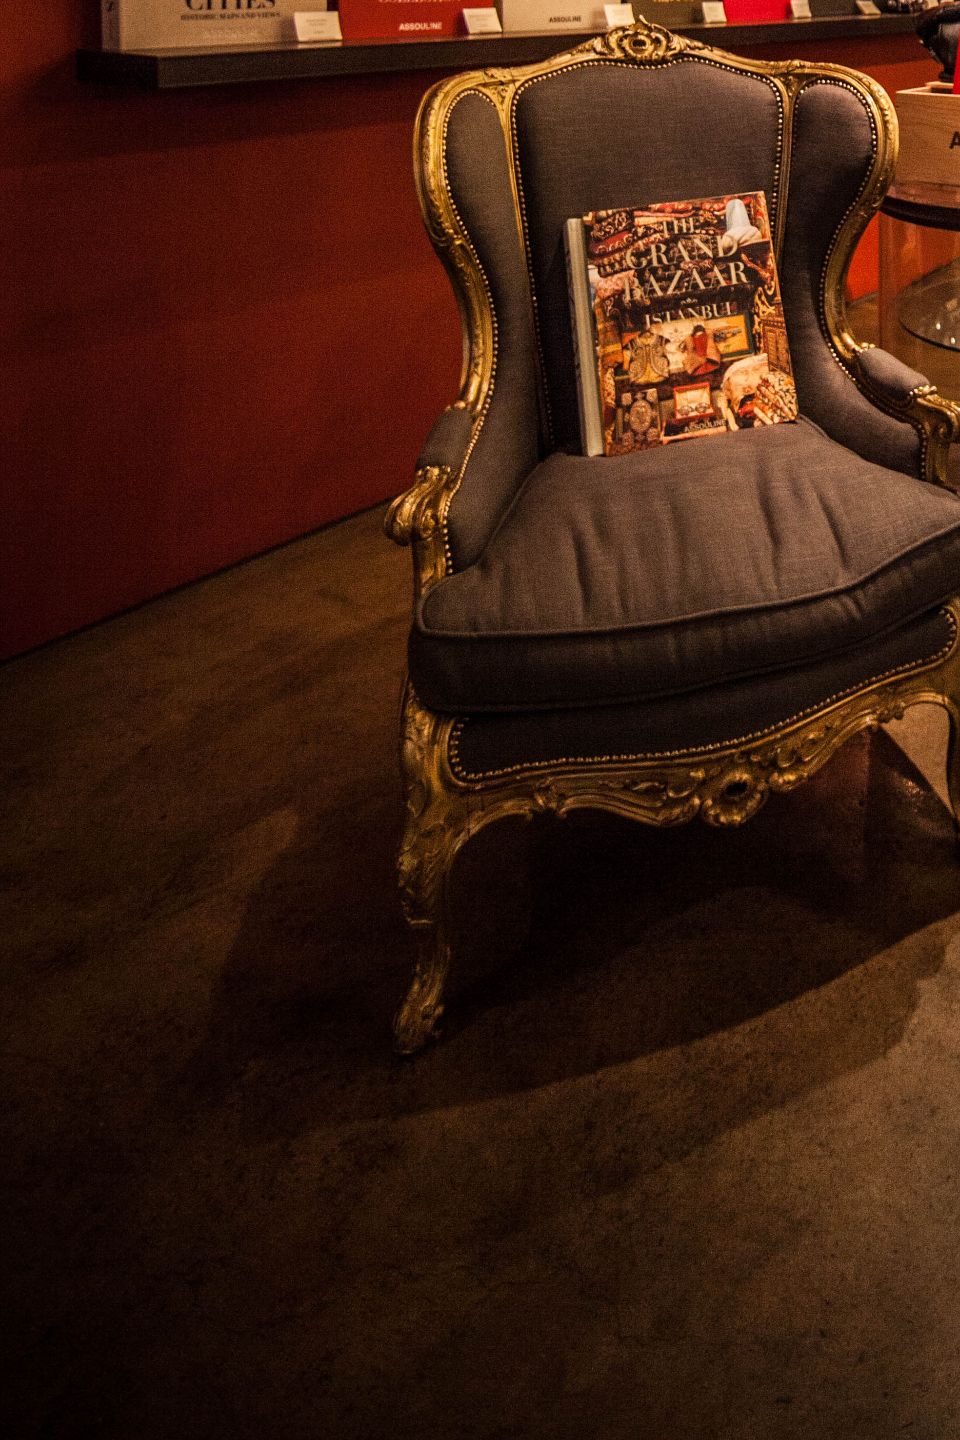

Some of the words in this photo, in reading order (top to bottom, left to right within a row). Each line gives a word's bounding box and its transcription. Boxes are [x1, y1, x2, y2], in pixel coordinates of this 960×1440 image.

[398, 22, 443, 32] ASSOULINE
[549, 15, 583, 23] ASSOULINE
[662, 217, 696, 236] THE
[625, 236, 740, 271] GRAND
[645, 302, 734, 328] ISTANBUL
